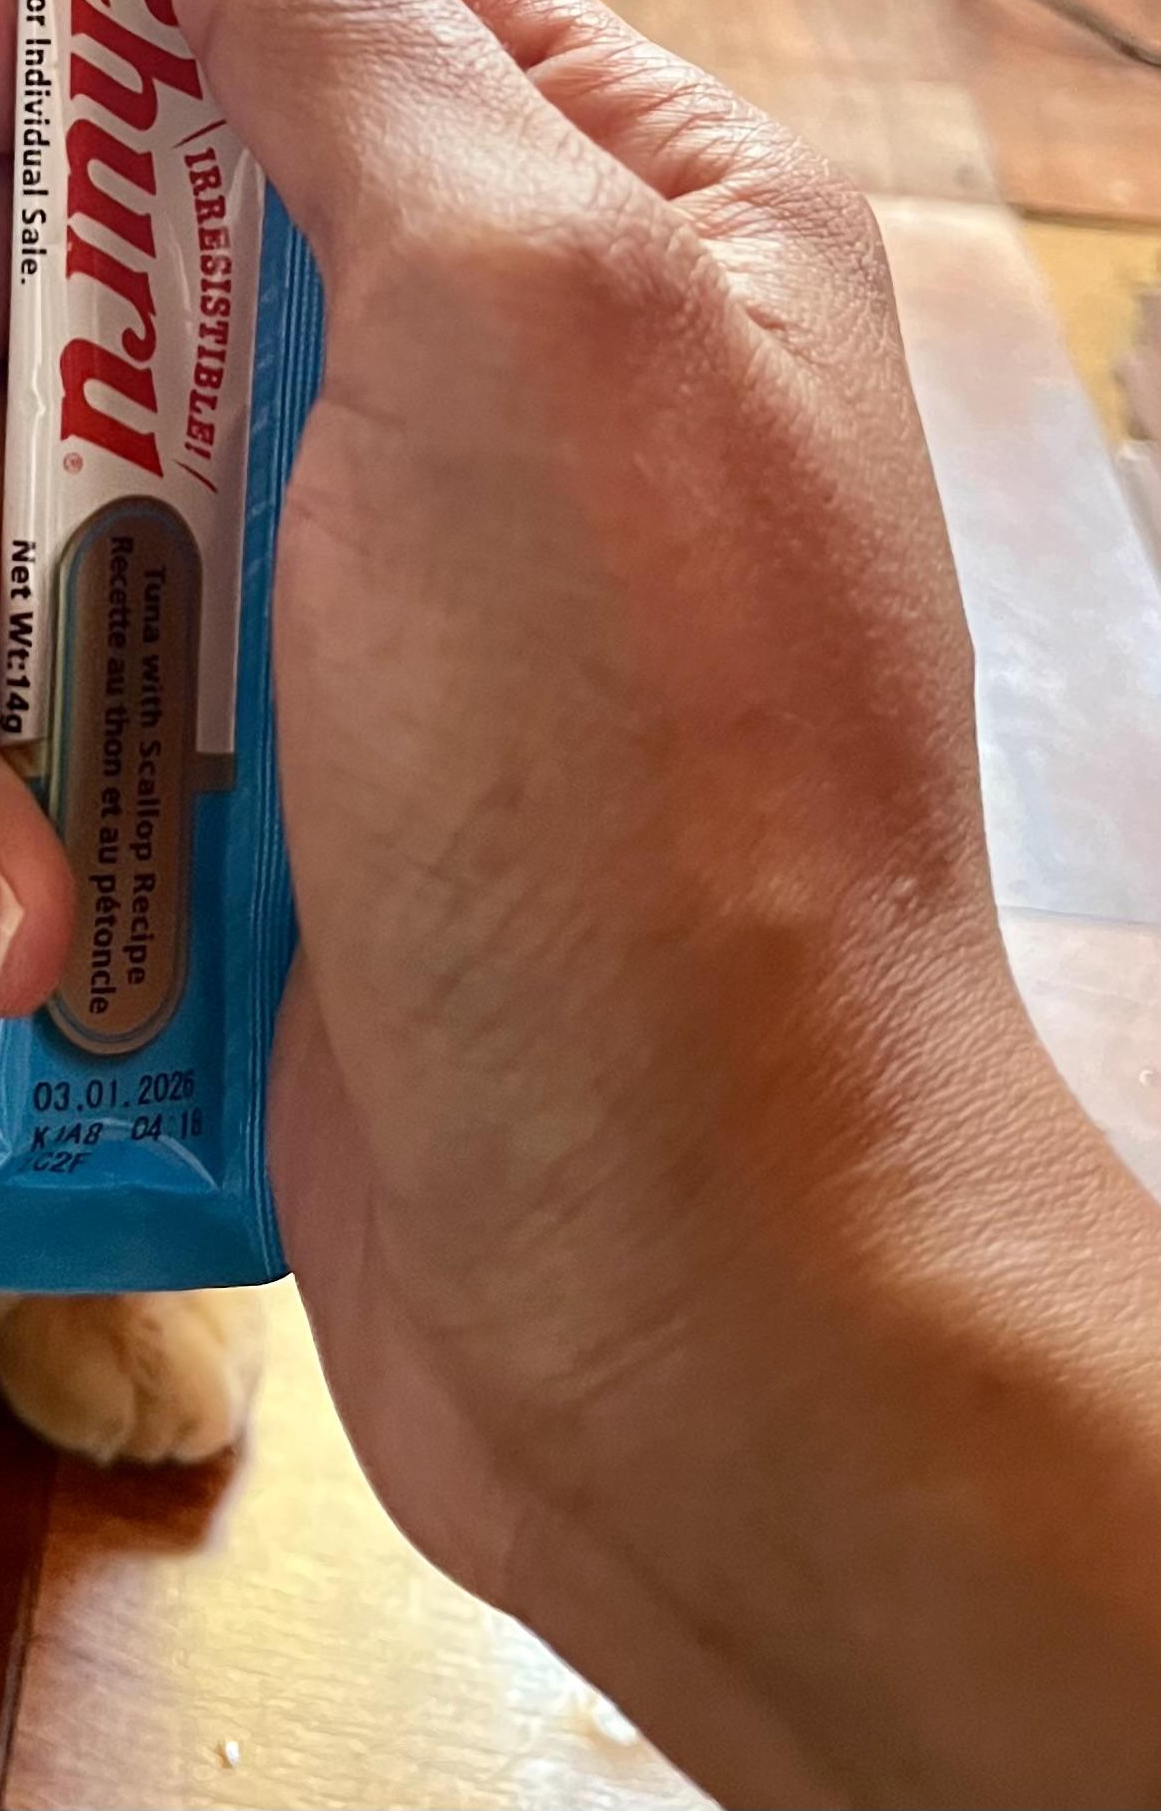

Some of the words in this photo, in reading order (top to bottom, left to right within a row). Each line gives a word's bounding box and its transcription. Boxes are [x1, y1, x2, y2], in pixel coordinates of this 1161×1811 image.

[23, 39, 52, 196] Individual
[21, 209, 47, 284] Sale.
[185, 147, 232, 460] IRRESISTIBLE!
[10, 540, 37, 600] Net
[107, 536, 133, 648] Recette
[143, 566, 166, 644] Tuna
[105, 656, 124, 694] au
[141, 655, 162, 727] with
[103, 708, 129, 777] thon
[101, 790, 121, 819] et
[130, 740, 161, 861] Scallop
[98, 829, 118, 864] au
[90, 874, 121, 1015] pétoncle
[123, 873, 156, 985] Recipe
[33, 1068, 195, 1112] 03.01.2026
